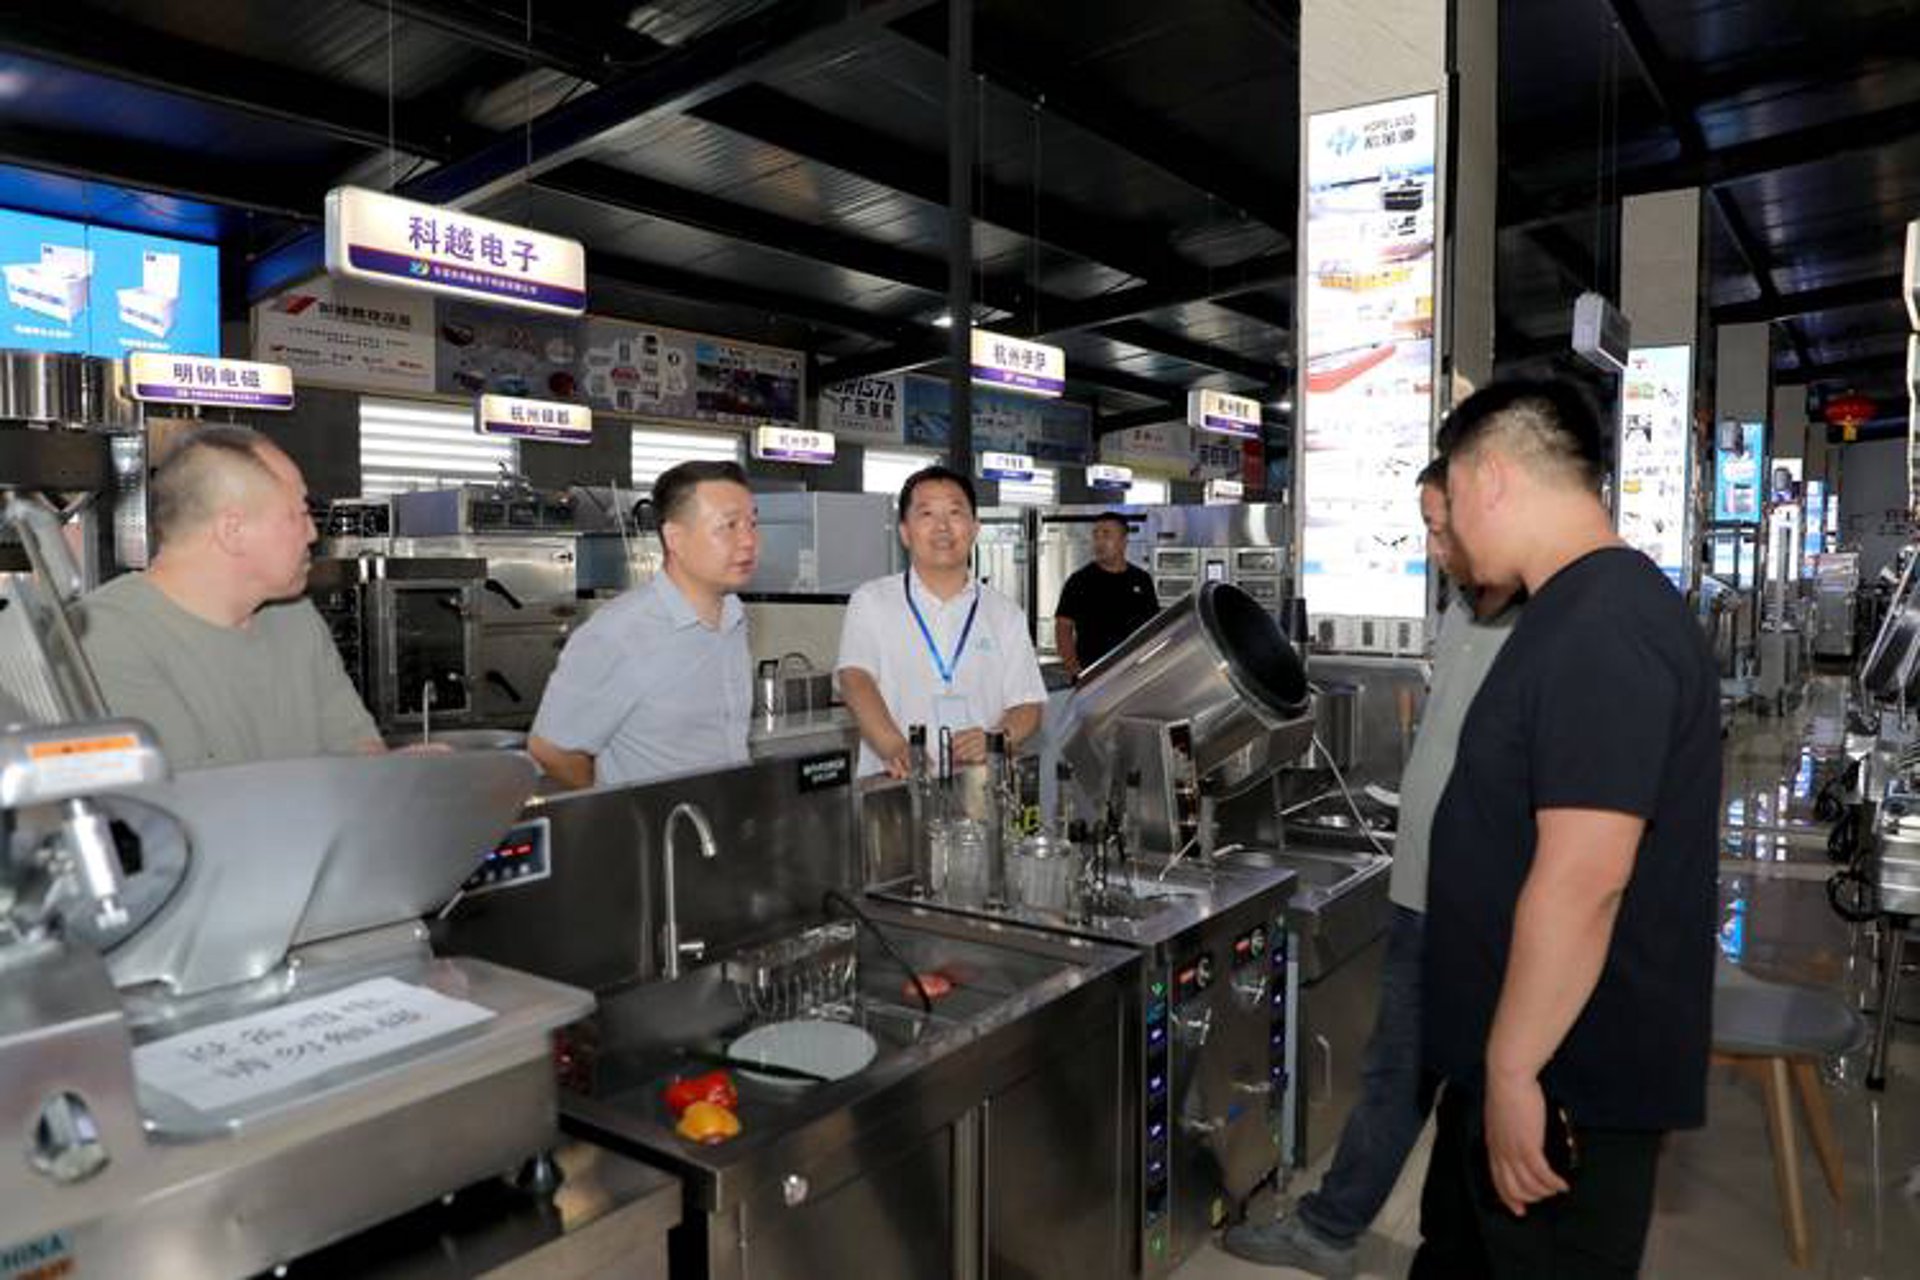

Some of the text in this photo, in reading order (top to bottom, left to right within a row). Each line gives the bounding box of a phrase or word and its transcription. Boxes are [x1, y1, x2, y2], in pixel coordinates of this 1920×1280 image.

[409, 215, 540, 273] 科越电子
[174, 353, 262, 388] 明锅电磁
